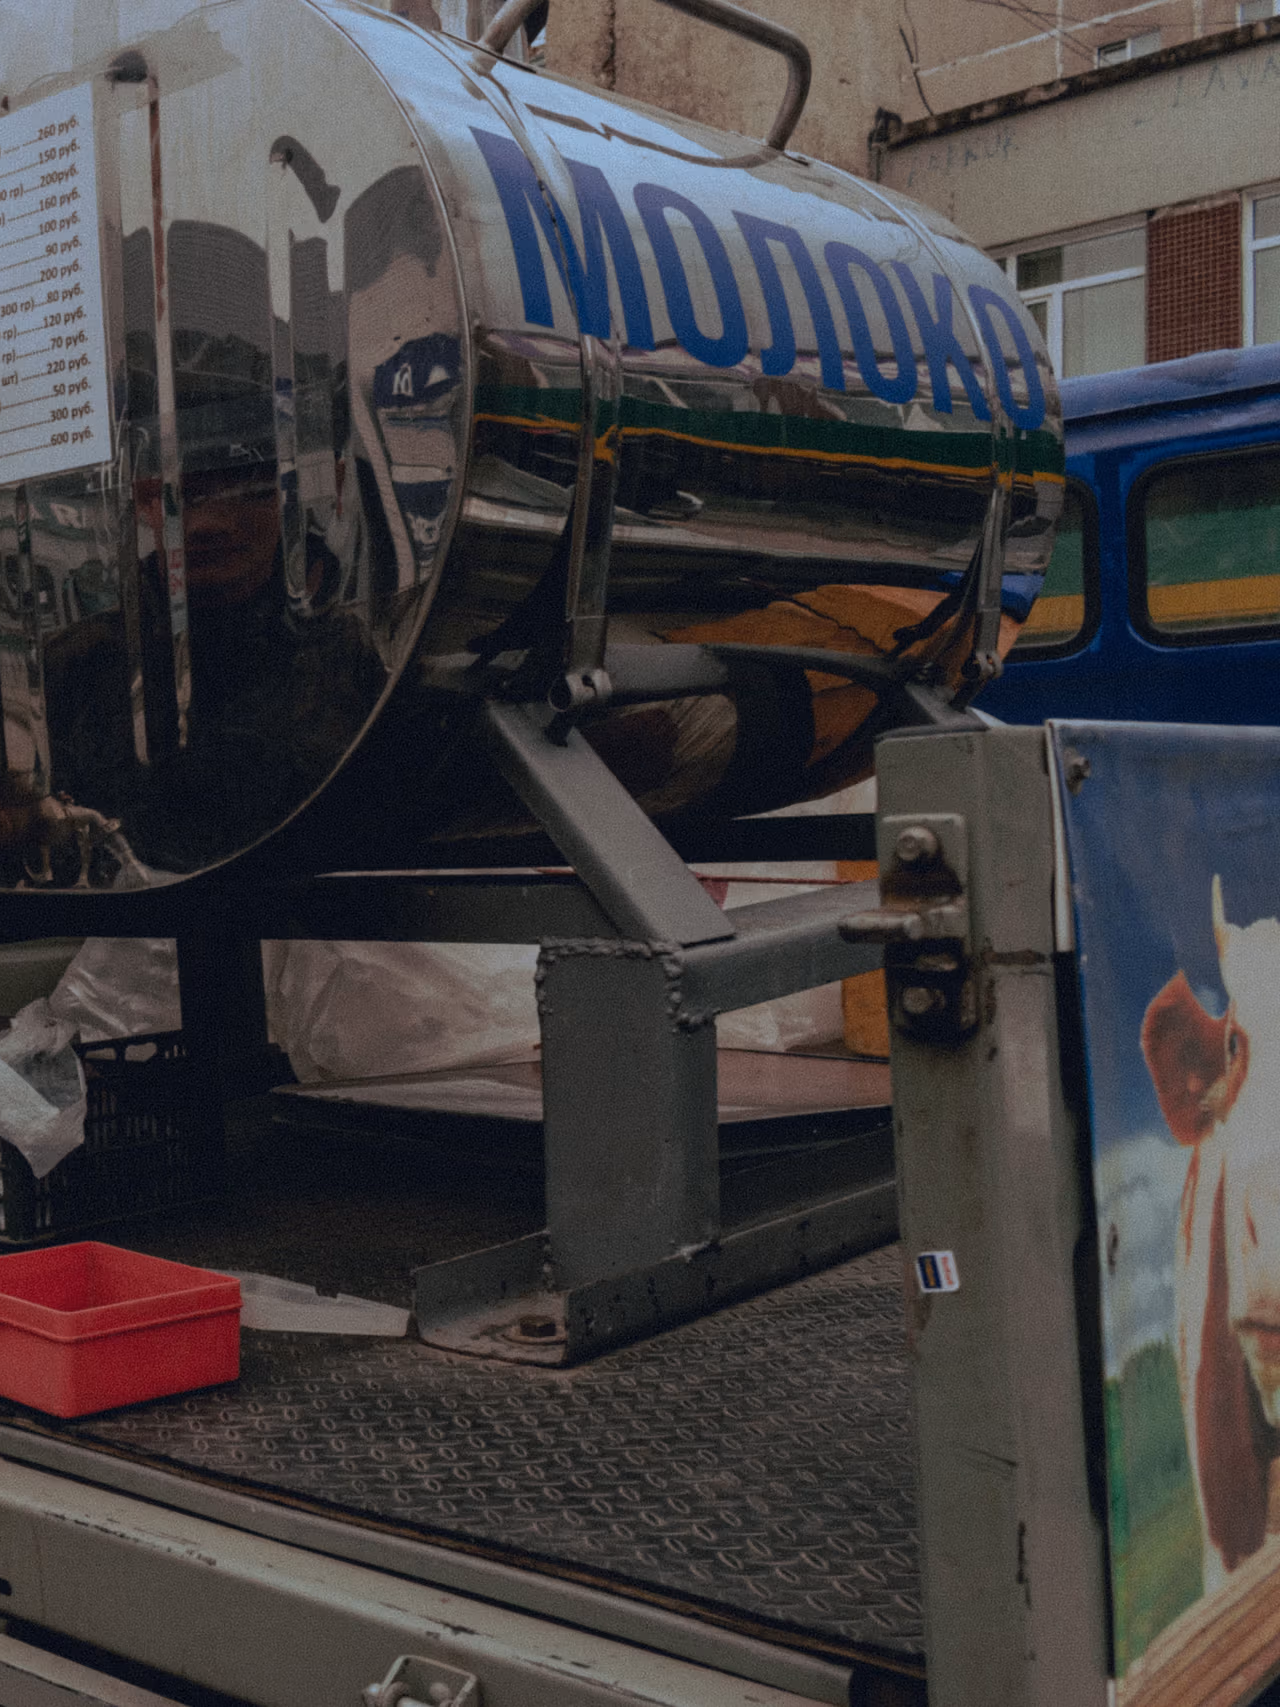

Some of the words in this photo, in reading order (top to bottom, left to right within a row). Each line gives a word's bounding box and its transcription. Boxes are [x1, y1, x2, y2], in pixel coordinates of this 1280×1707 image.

[57, 115, 78, 135] руб.
[58, 138, 80, 159] руб.
[9, 183, 25, 199] гр)
[59, 187, 80, 207] руб.
[59, 210, 80, 231] руб.
[60, 235, 82, 254] руб.
[60, 258, 81, 278] руб.
[470, 128, 1047, 431] МОЛОКО
[19, 297, 36, 312] гр)
[61, 282, 83, 302] руб.
[2, 326, 18, 341] гр)
[63, 305, 86, 325] руб.
[1, 349, 17, 365] гр)
[65, 330, 88, 349] руб.
[1, 372, 19, 387] шт)
[68, 353, 90, 372] руб.
[68, 377, 91, 395] руб.
[71, 401, 93, 420] руб.
[71, 426, 93, 444] руб.
